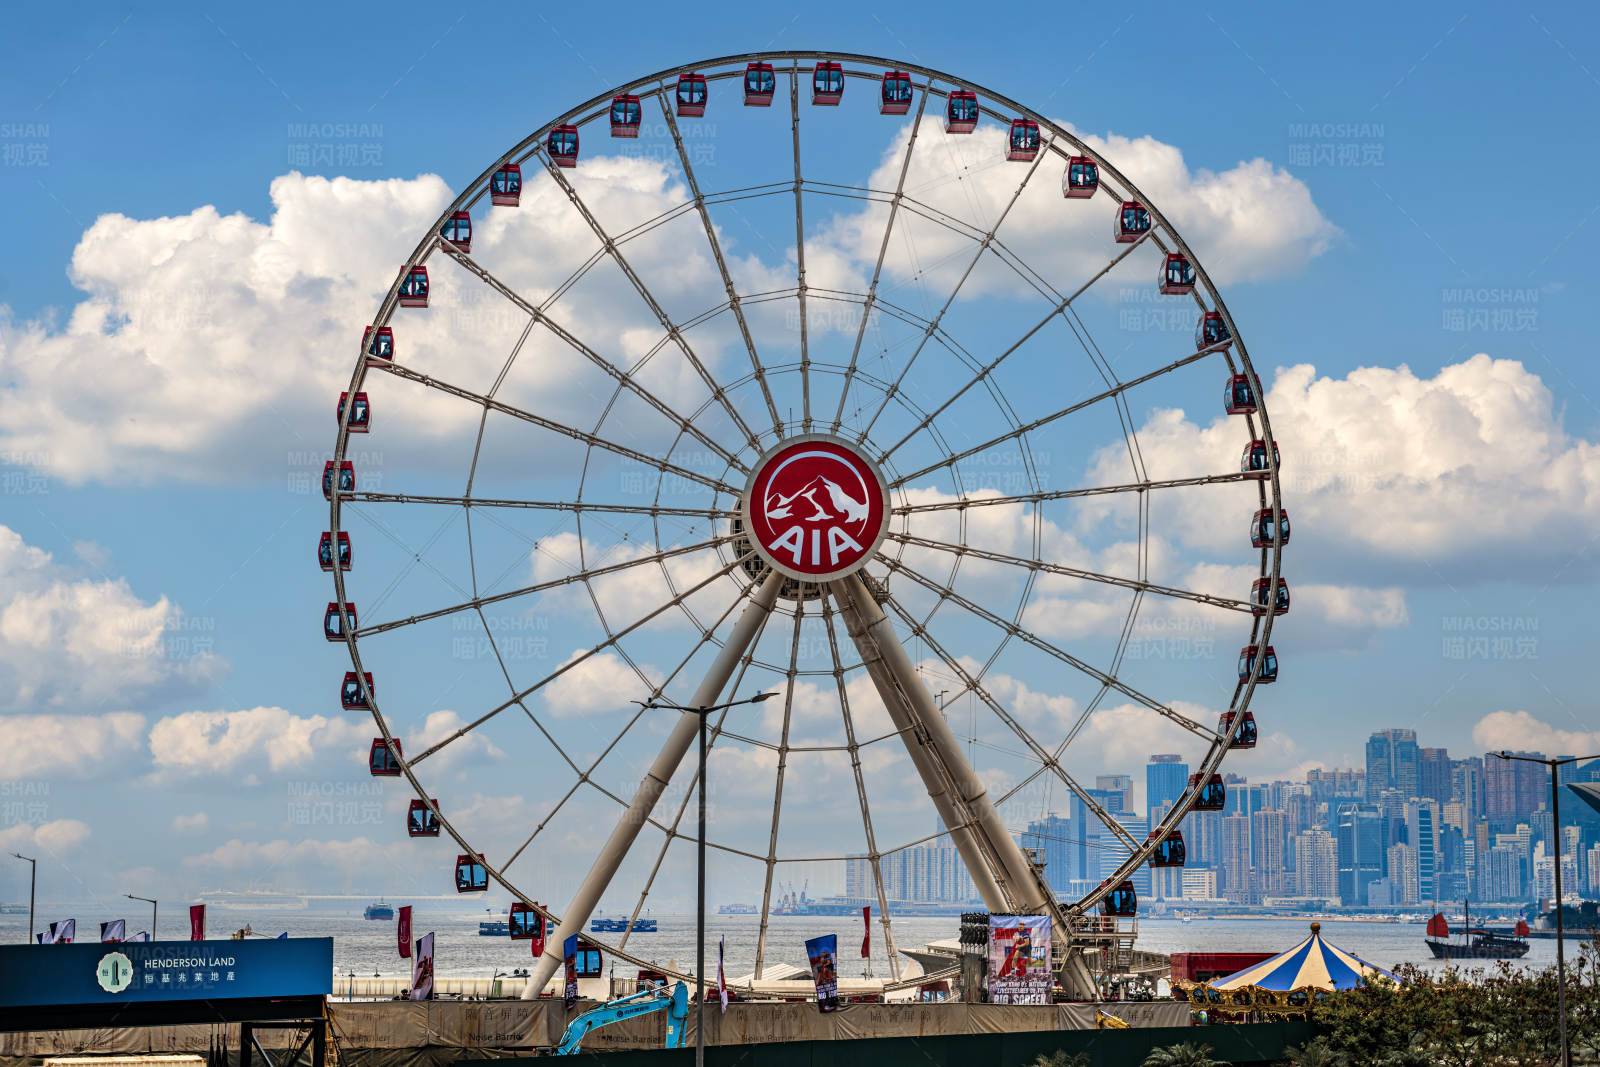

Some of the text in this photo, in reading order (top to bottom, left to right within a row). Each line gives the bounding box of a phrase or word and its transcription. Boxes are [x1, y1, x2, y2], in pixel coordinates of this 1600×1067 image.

[768, 525, 864, 566] AIA
[144, 957, 236, 969] HENDERSON LAND
[144, 971, 236, 984] 恒基兆業地產
[469, 1032, 523, 1042] Noise Barrier
